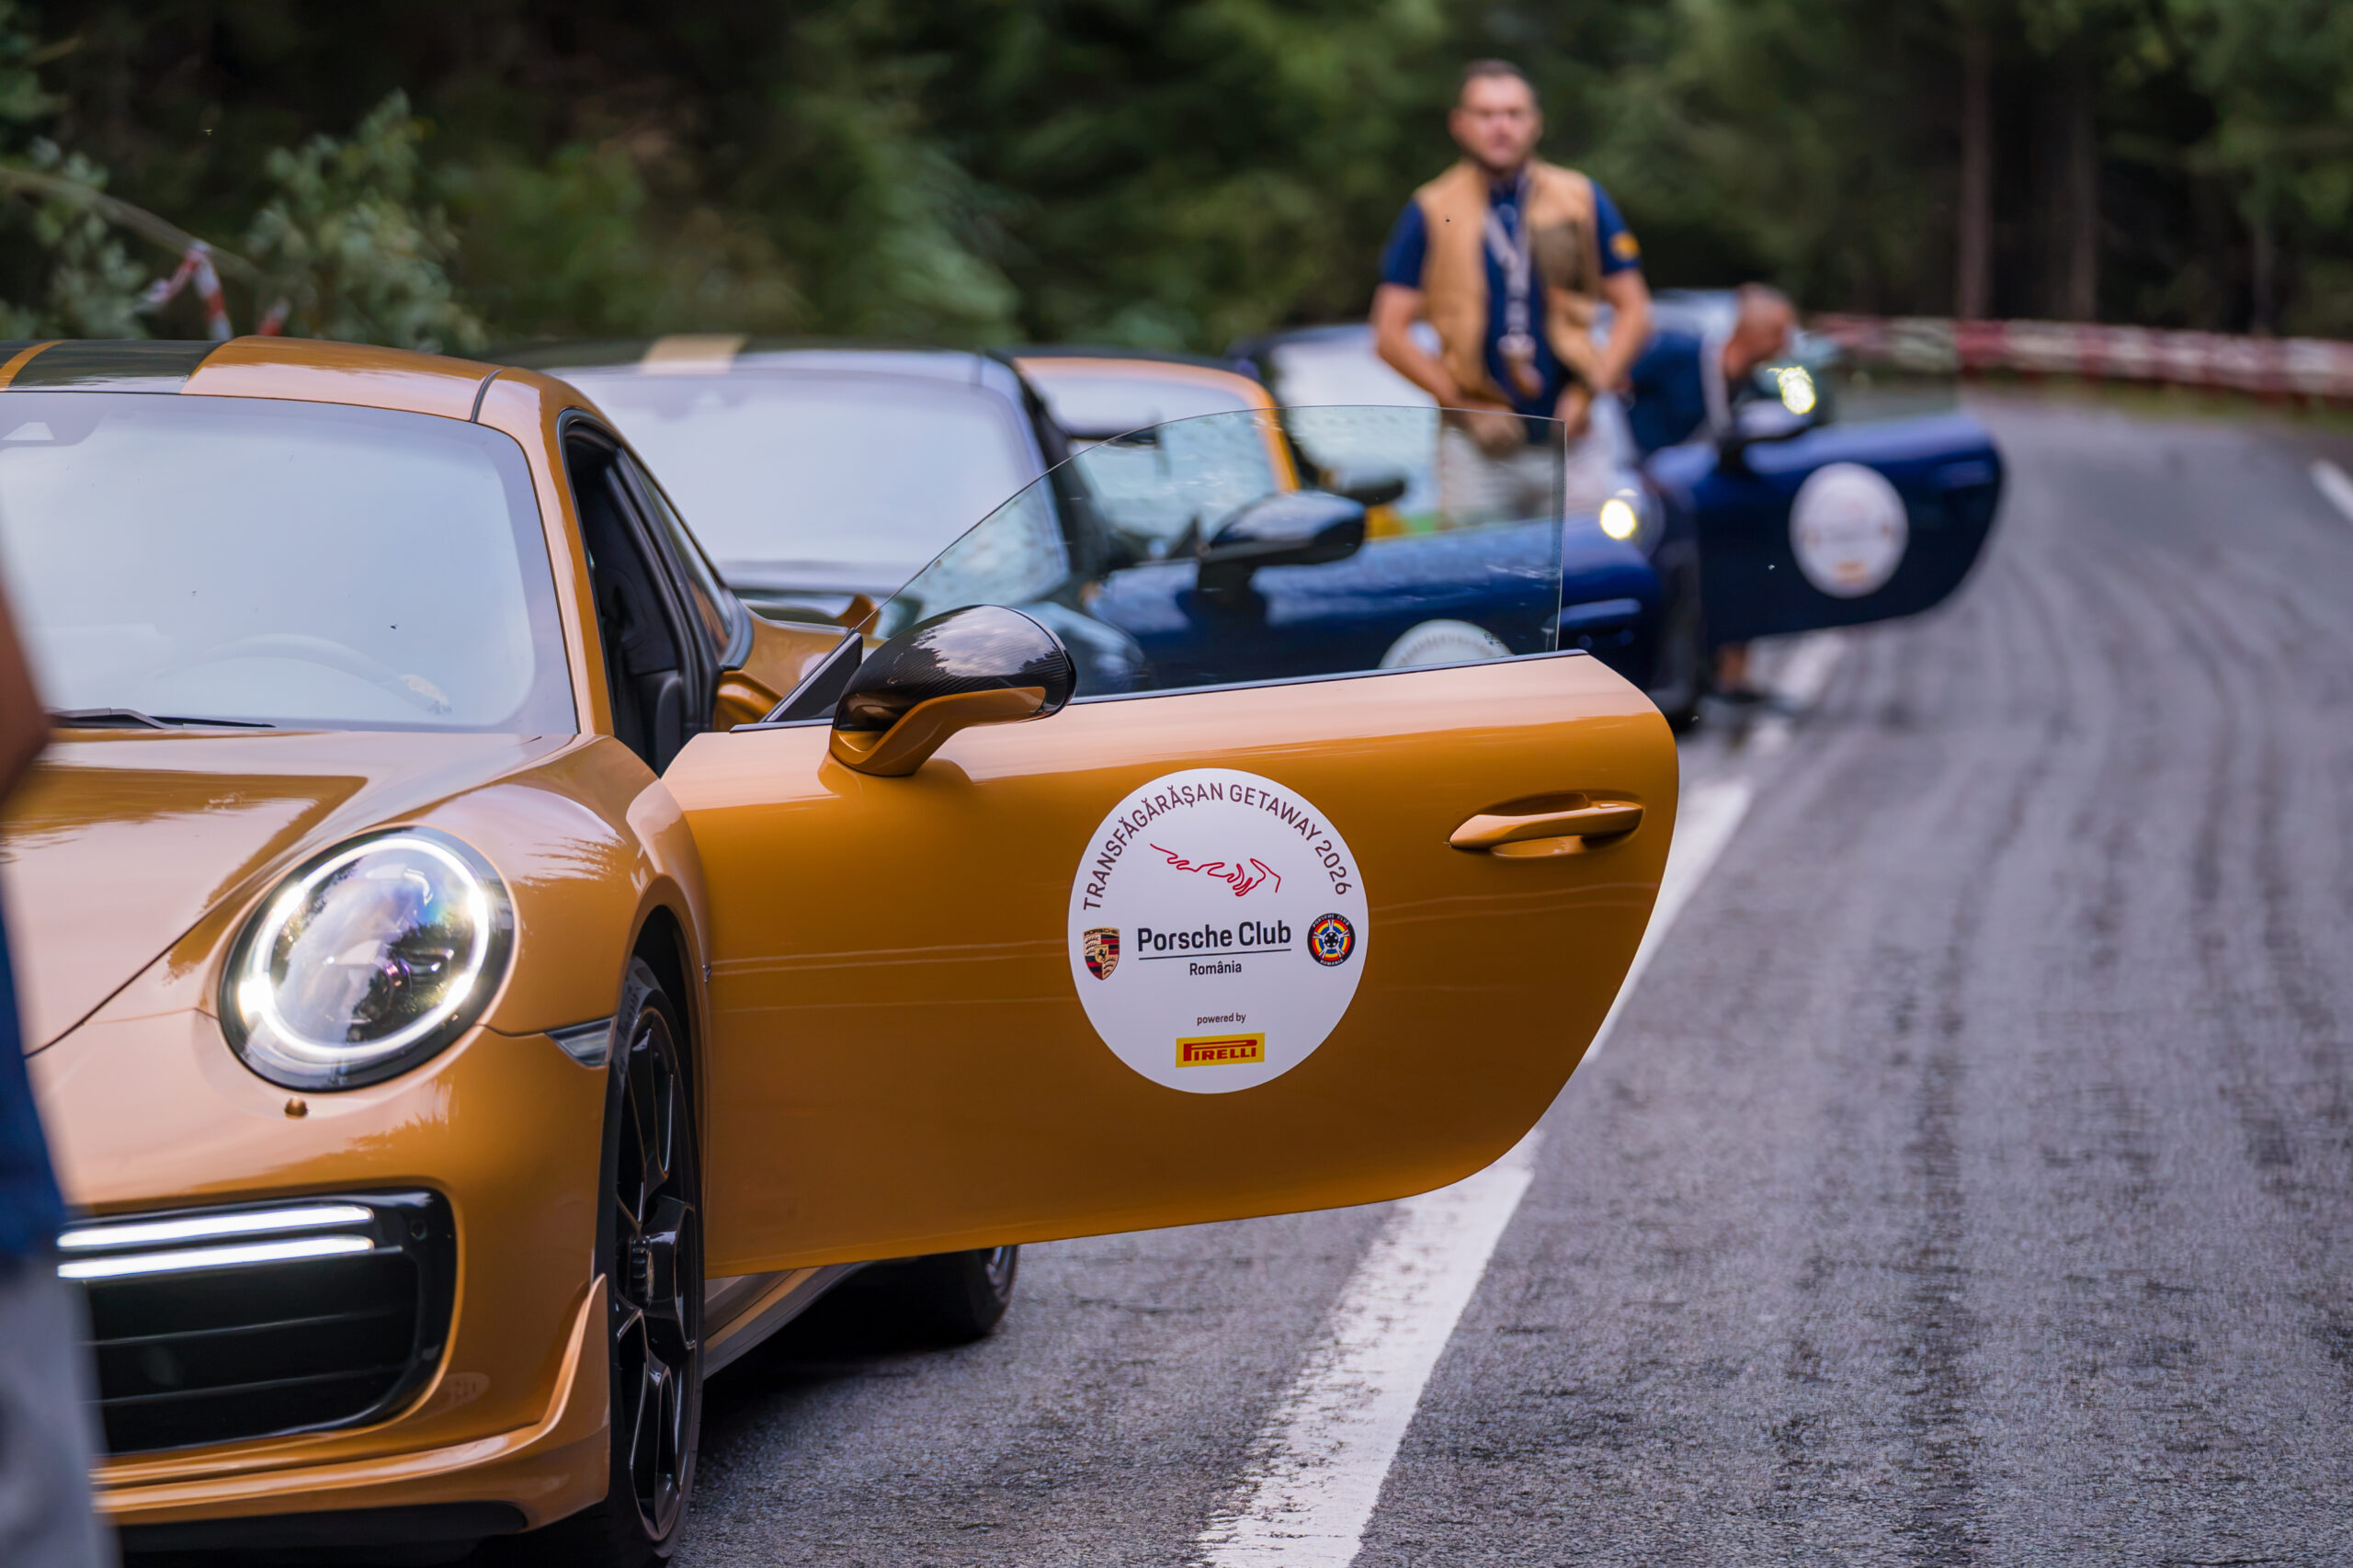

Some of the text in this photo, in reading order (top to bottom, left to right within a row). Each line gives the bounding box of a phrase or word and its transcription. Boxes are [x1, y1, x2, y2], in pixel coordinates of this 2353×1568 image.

[1230, 784, 1322, 842] GETAWAY
[1314, 839, 1352, 895] 2026
[1137, 920, 1291, 952] Porsche Club
[1189, 960, 1242, 976] România
[1197, 1012, 1246, 1026] powered by
[1183, 1039, 1257, 1062] PIRELLI
